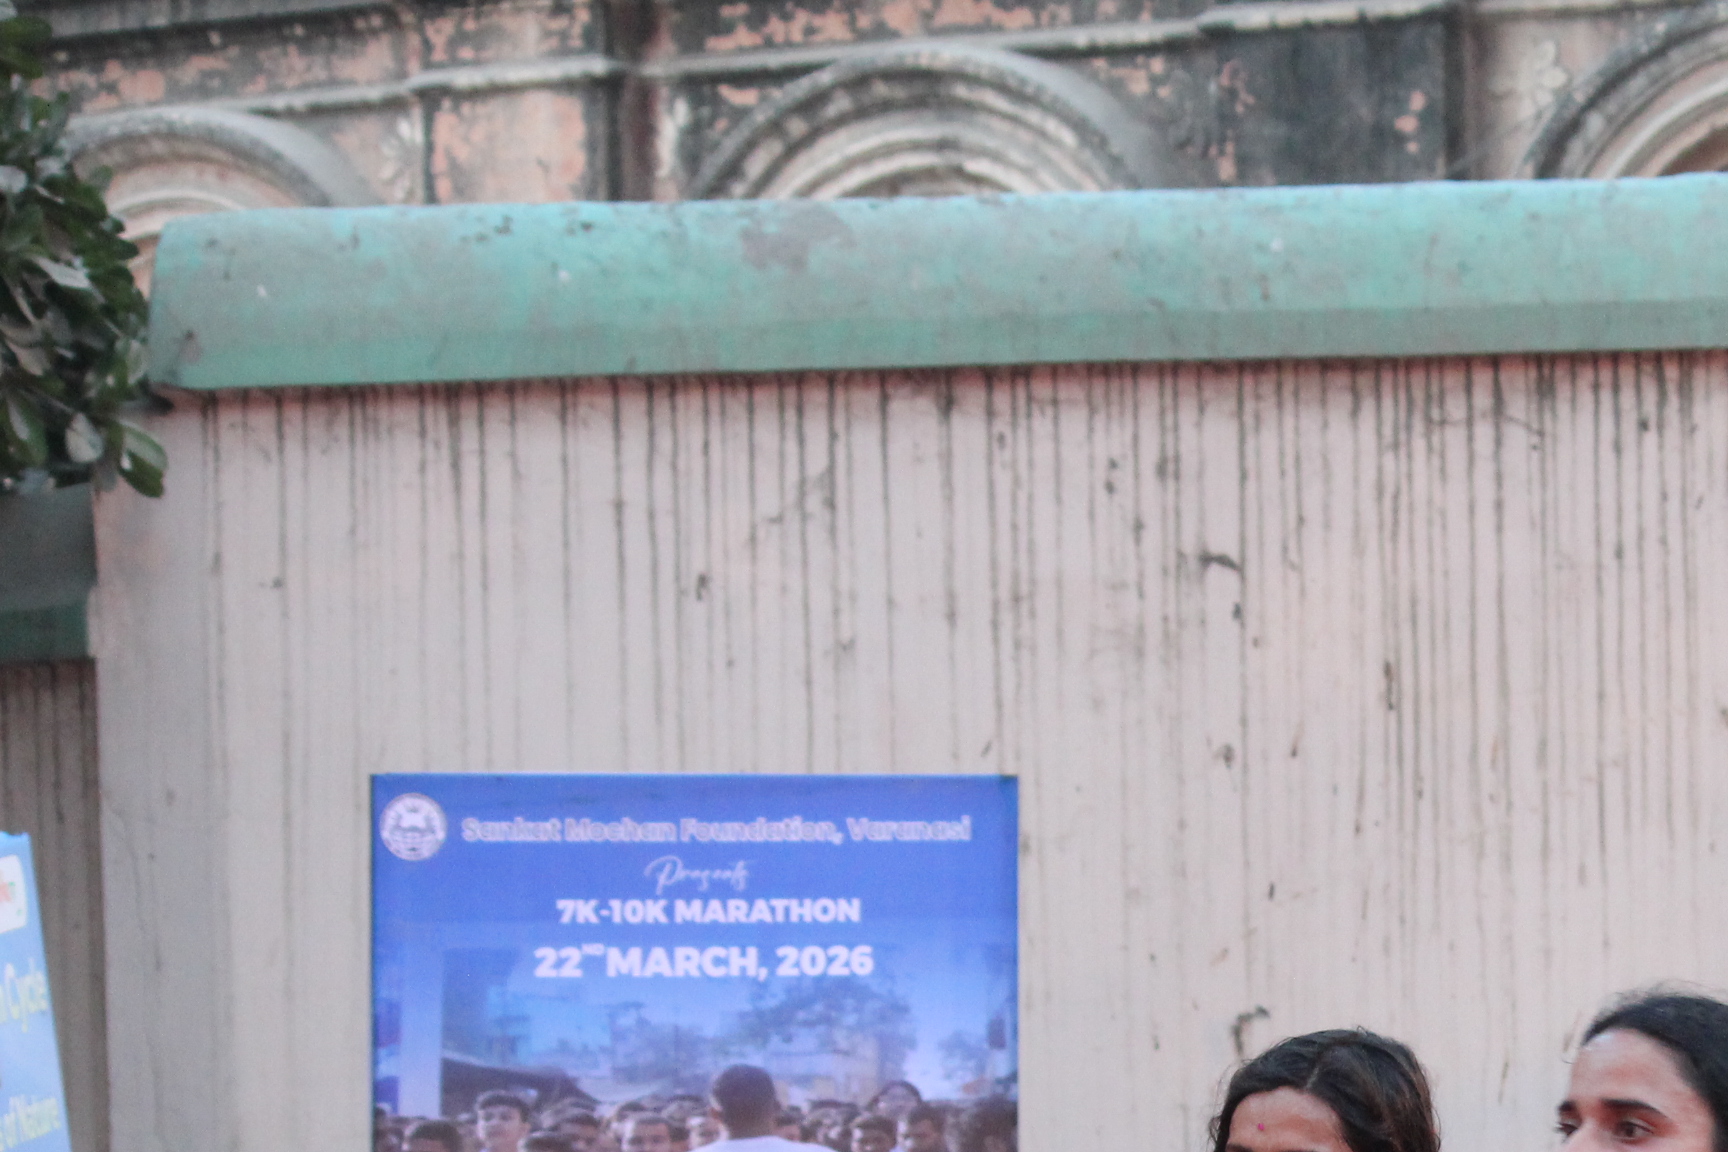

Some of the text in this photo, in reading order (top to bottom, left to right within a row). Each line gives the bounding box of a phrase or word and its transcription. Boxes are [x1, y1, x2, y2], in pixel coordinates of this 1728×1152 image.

[461, 818, 561, 843] Sankat
[565, 817, 676, 842] Mochan
[847, 815, 972, 842] Varanasi
[556, 897, 863, 925] 7K-10K MARATHON
[775, 945, 875, 977] 2026
